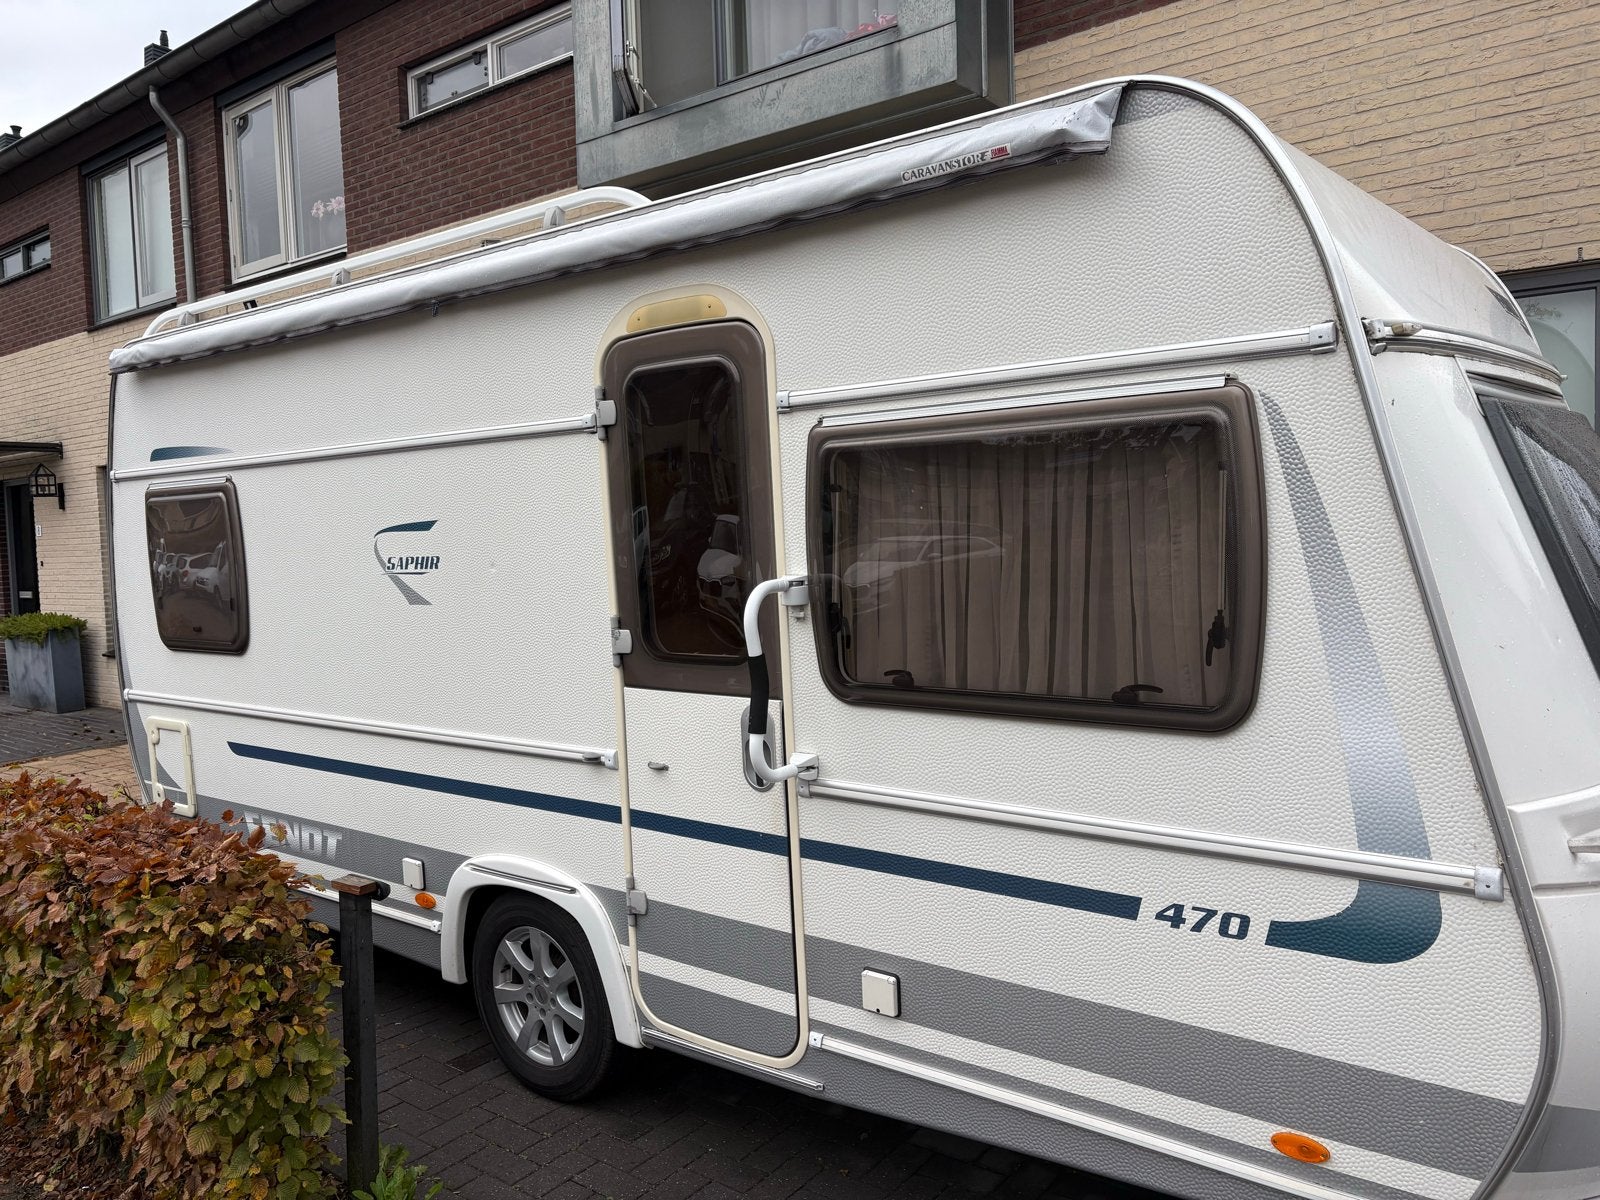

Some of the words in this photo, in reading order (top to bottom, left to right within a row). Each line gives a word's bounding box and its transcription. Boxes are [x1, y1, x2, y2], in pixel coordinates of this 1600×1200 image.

[902, 151, 989, 181] CARAVANSTORE
[386, 555, 441, 571] SAPHIR
[1155, 903, 1251, 940] 470
